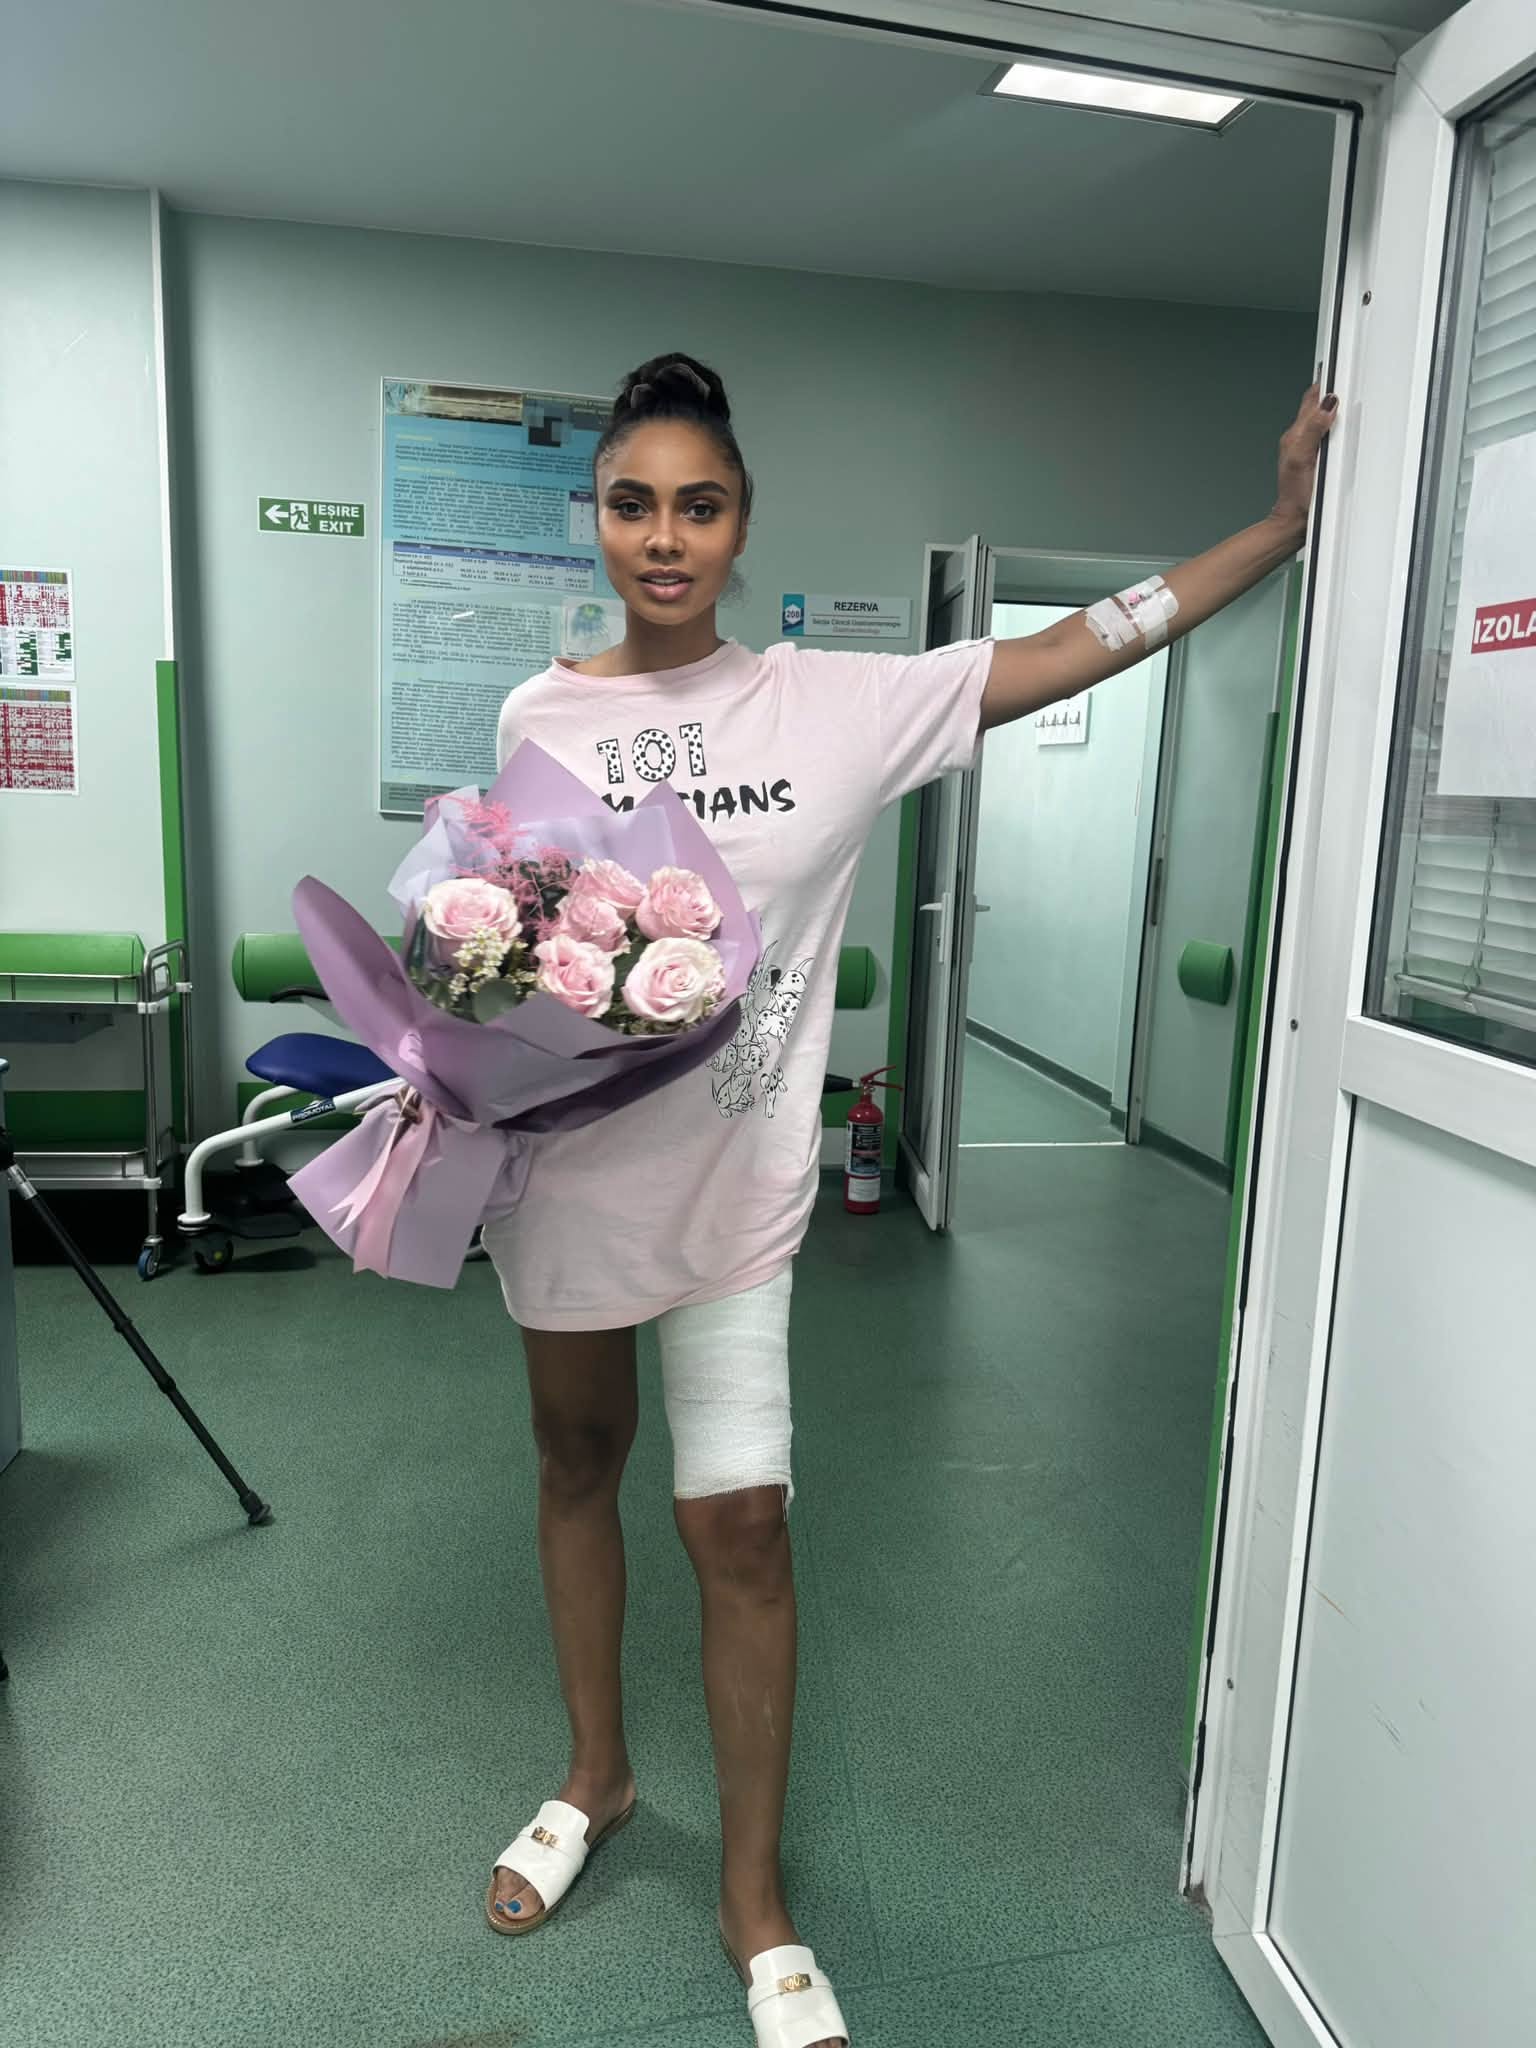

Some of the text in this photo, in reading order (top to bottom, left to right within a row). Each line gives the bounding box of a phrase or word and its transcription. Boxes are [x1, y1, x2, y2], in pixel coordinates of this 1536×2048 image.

[313, 504, 360, 519] IEȘIRE
[320, 520, 354, 533] EXIT
[833, 601, 879, 612] REZERVA
[596, 722, 707, 785] 101
